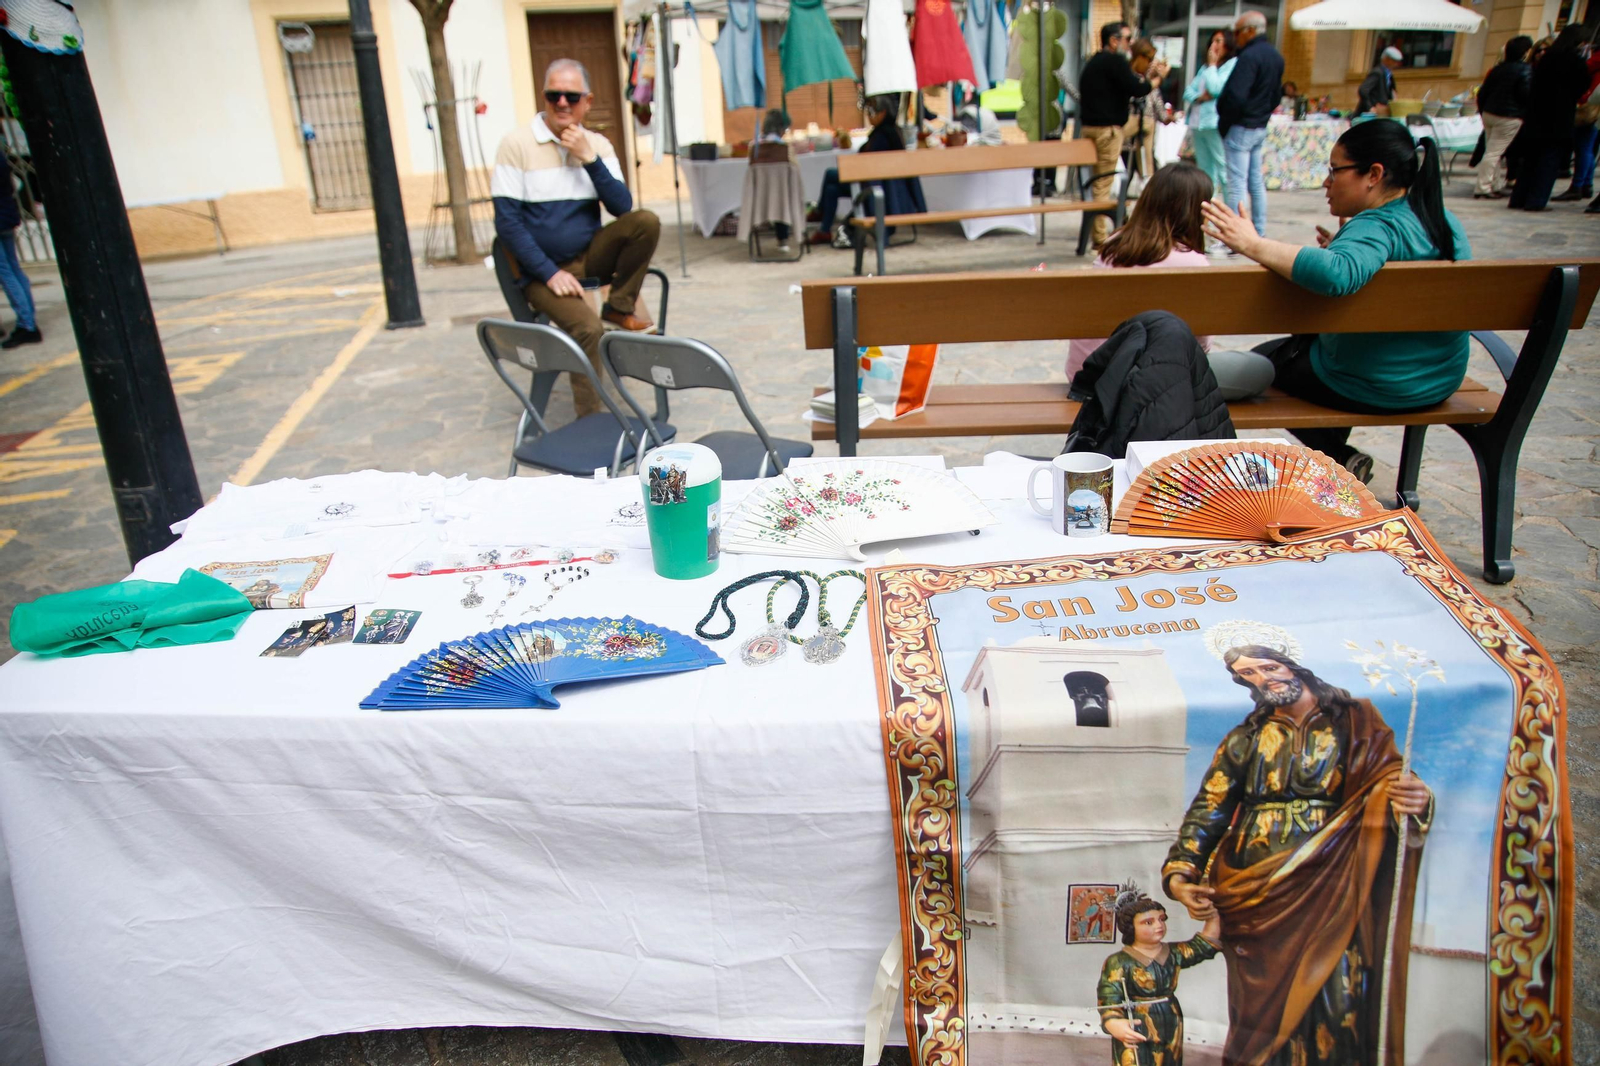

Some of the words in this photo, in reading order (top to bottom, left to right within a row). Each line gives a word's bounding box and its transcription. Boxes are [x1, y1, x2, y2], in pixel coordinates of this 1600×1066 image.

[986, 595, 1096, 624] San
[1115, 577, 1239, 613] José
[1058, 616, 1202, 642] Abrucena
